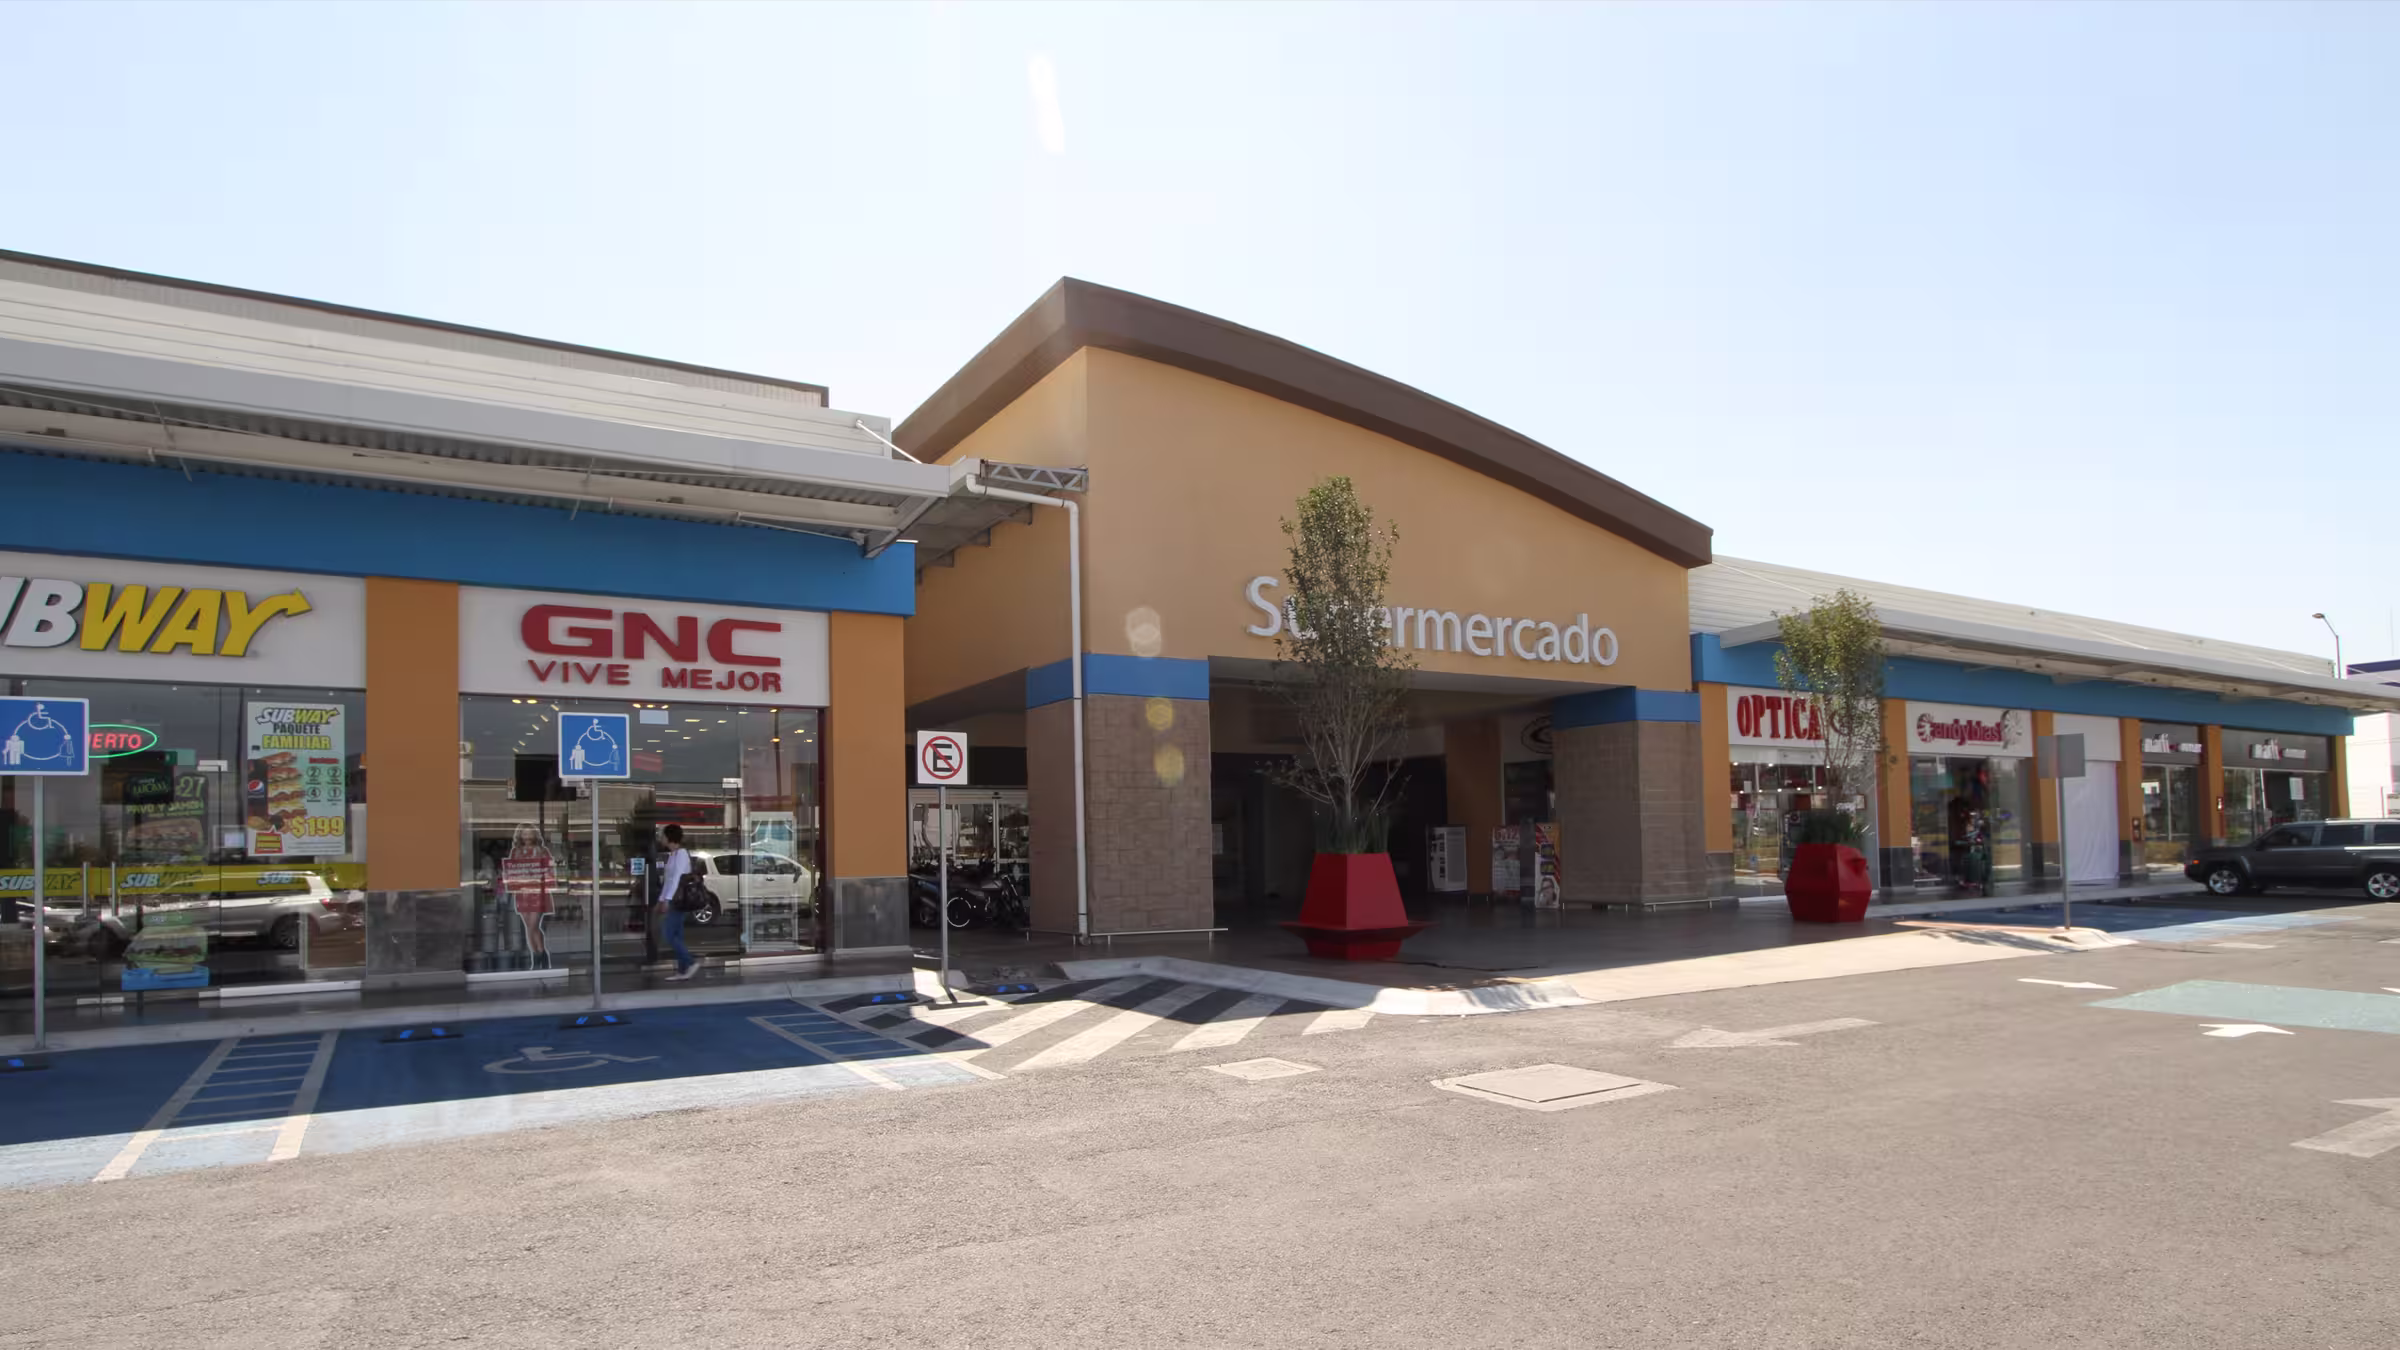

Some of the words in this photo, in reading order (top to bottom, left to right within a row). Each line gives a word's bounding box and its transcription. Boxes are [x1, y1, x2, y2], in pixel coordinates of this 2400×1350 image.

[1246, 575, 1619, 666] Suermercado
[521, 604, 782, 667] GNC
[527, 659, 630, 686] VIVE
[661, 667, 781, 693] MEJOR
[255, 707, 341, 724] SUBWAY
[262, 734, 332, 750] FAMILIAR
[273, 723, 321, 735] PAQUETE
[933, 743, 953, 772] E
[291, 815, 345, 838] $199
